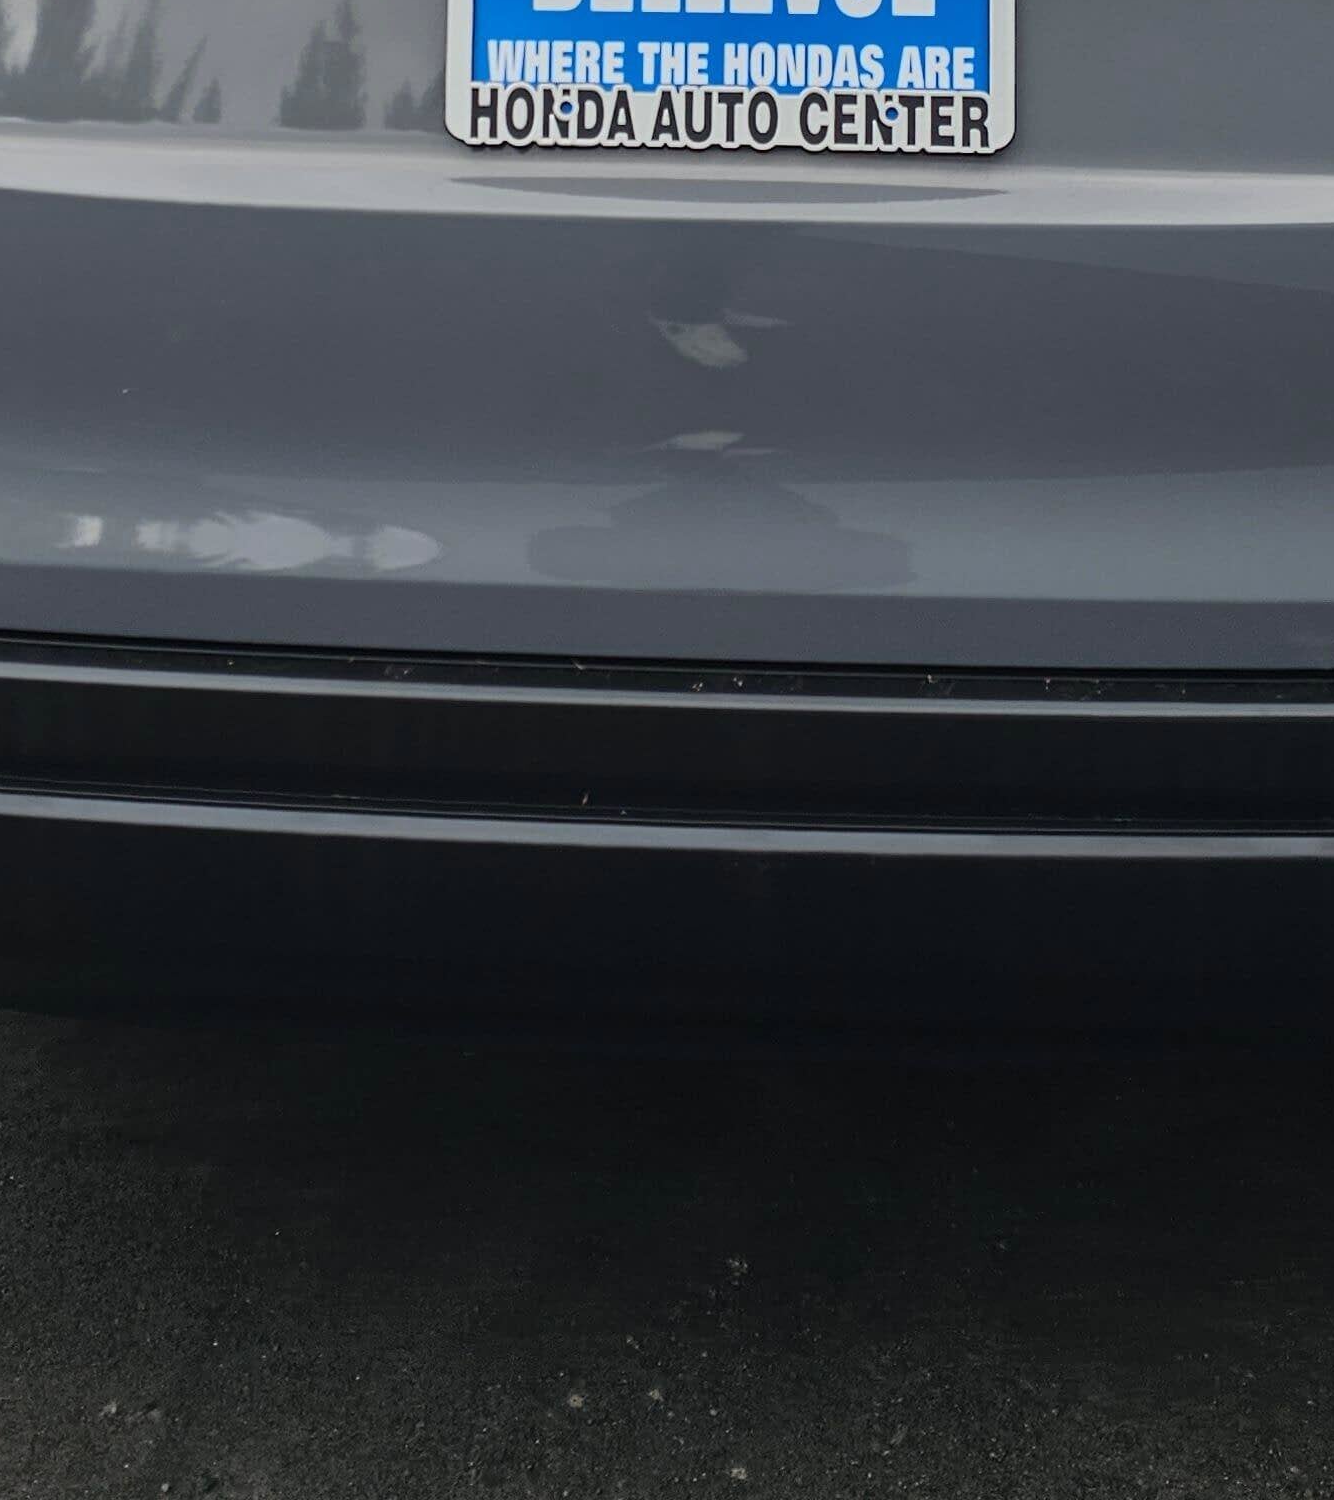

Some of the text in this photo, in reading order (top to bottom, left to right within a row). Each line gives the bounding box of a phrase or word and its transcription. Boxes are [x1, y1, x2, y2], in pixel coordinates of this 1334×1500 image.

[487, 39, 975, 90] WHERE THE HONDAS ARE
[470, 88, 990, 148] HONDA AUTO CENTER
